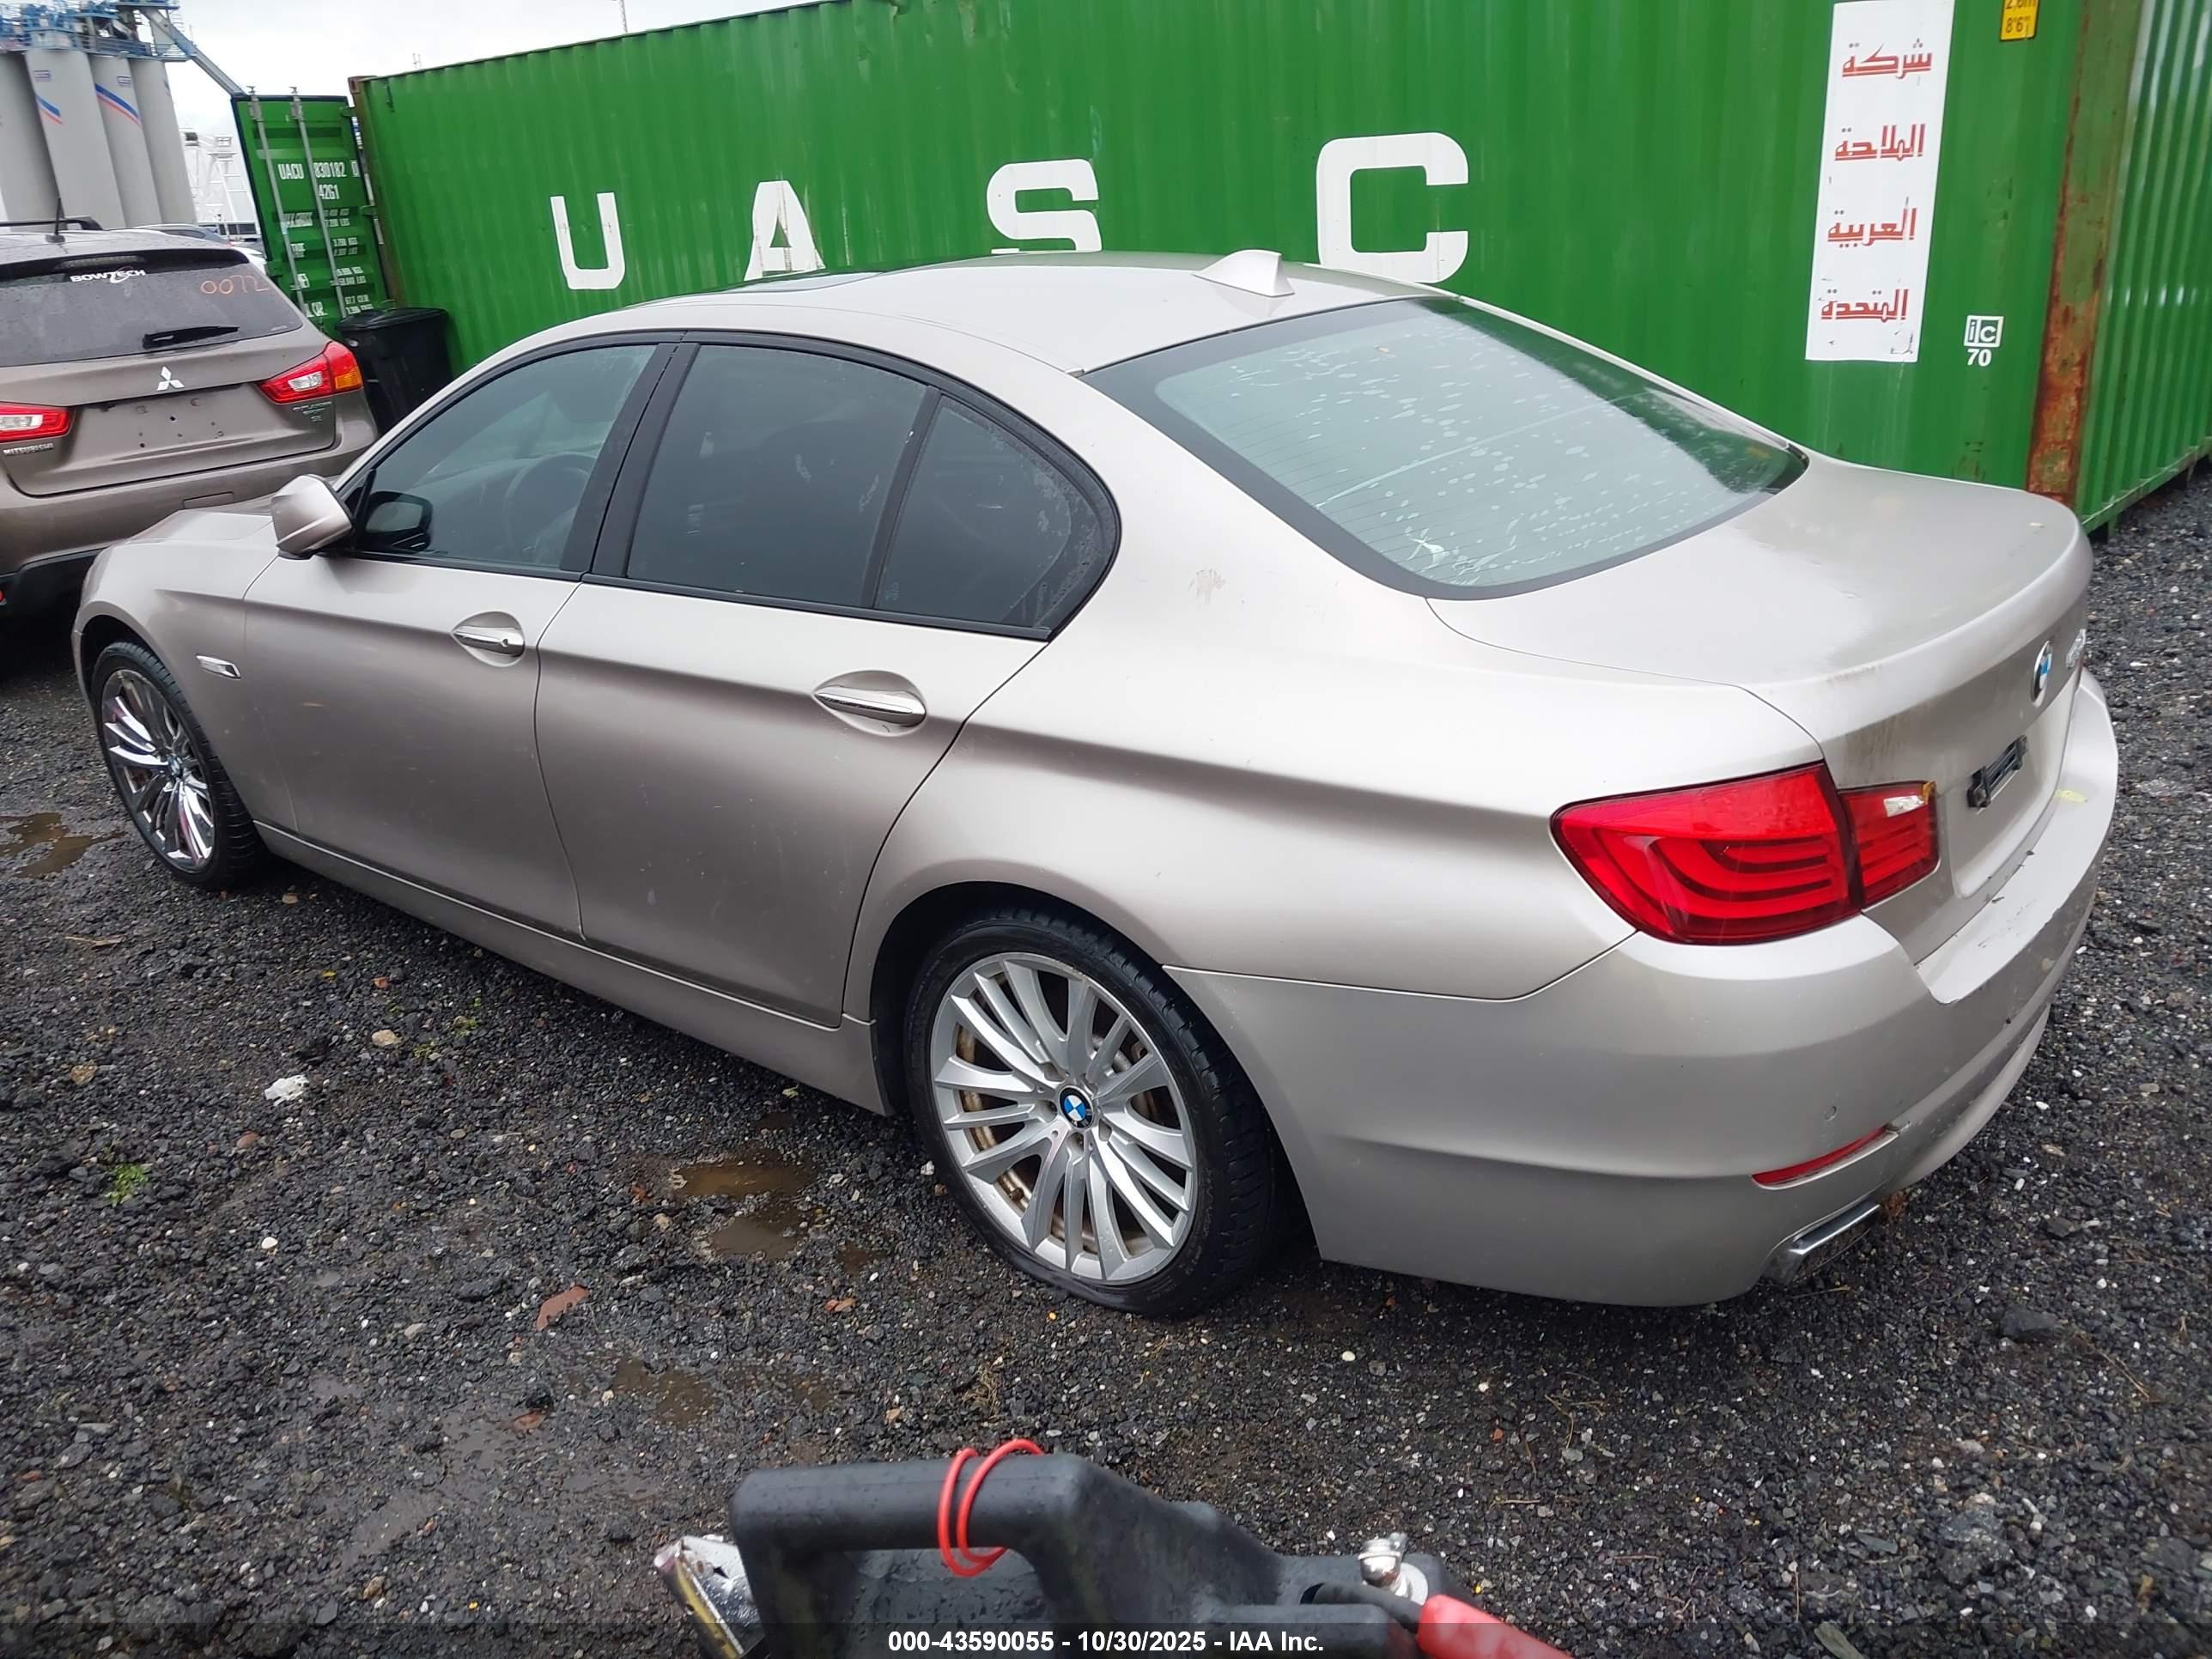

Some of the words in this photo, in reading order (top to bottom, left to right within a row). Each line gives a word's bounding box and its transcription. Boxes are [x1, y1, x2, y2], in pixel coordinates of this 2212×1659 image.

[1842, 38, 1932, 80] شركة
[1835, 123, 1925, 162] الملاحة
[277, 162, 304, 179] UACU
[1827, 207, 1917, 248] العربية
[70, 269, 146, 284] BOWTECH
[1821, 289, 1908, 323] المتحدة
[1967, 348, 1992, 367] 70
